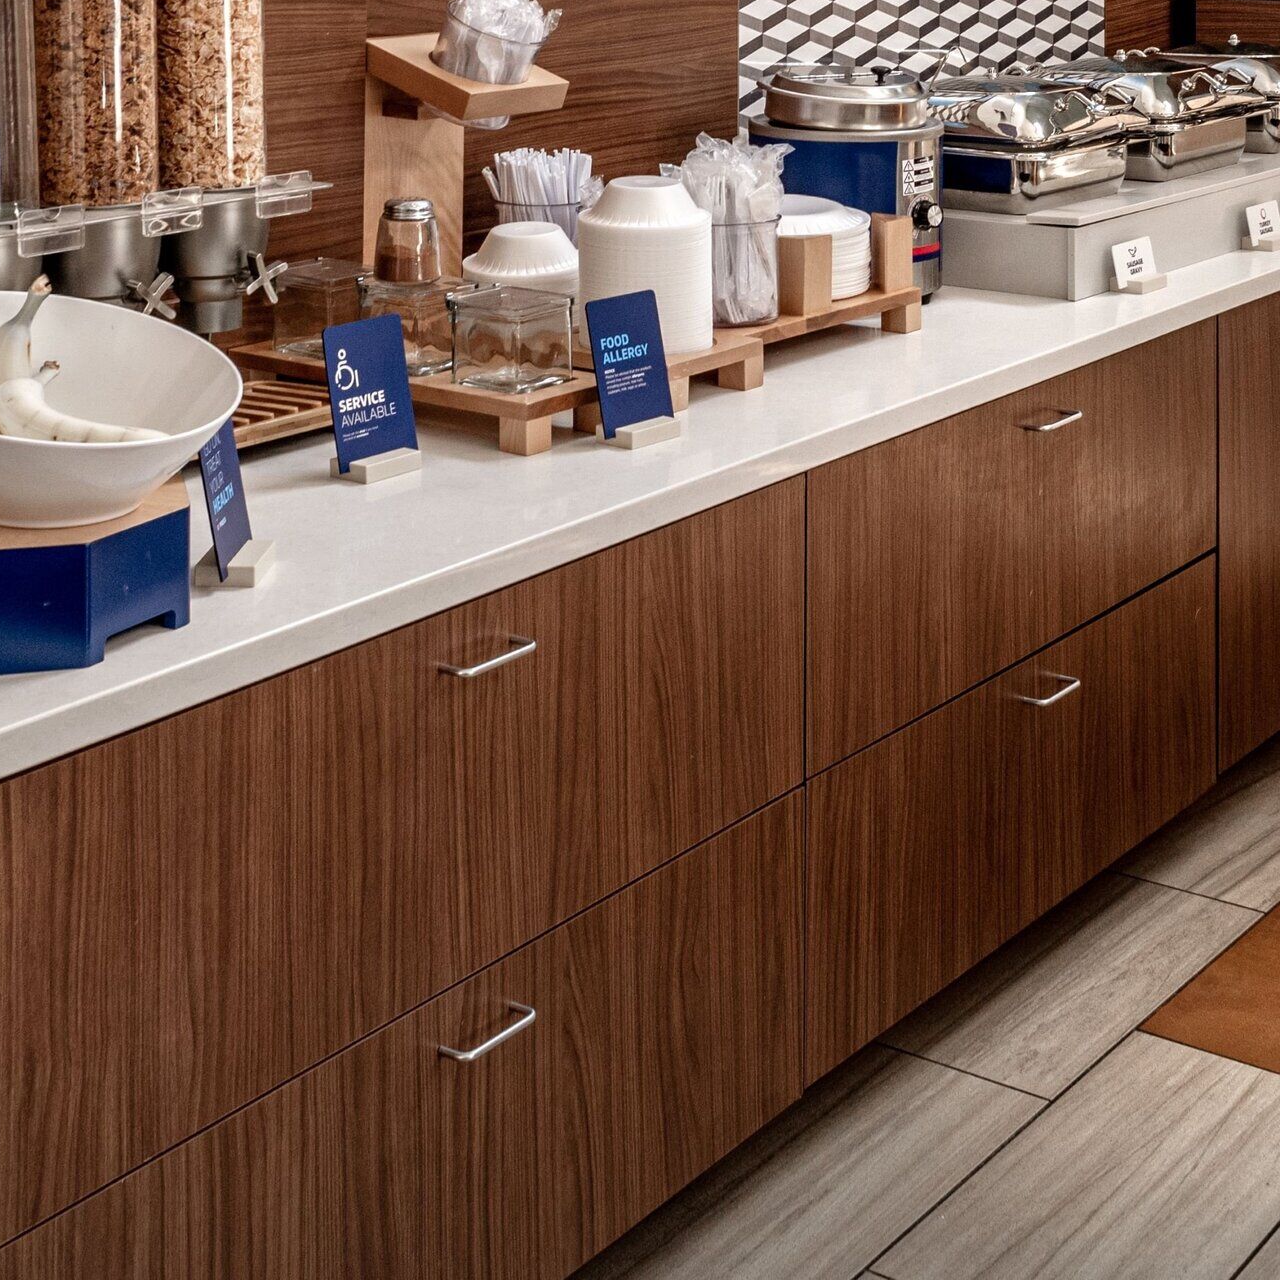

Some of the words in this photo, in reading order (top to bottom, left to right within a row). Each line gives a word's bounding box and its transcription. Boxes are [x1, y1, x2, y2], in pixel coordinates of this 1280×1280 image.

[600, 333, 629, 351] FOOD
[603, 342, 649, 365] ALLERGY
[338, 389, 386, 413] SERVICE
[341, 402, 397, 429] AVAILABLE
[212, 480, 235, 516] HEALTH
